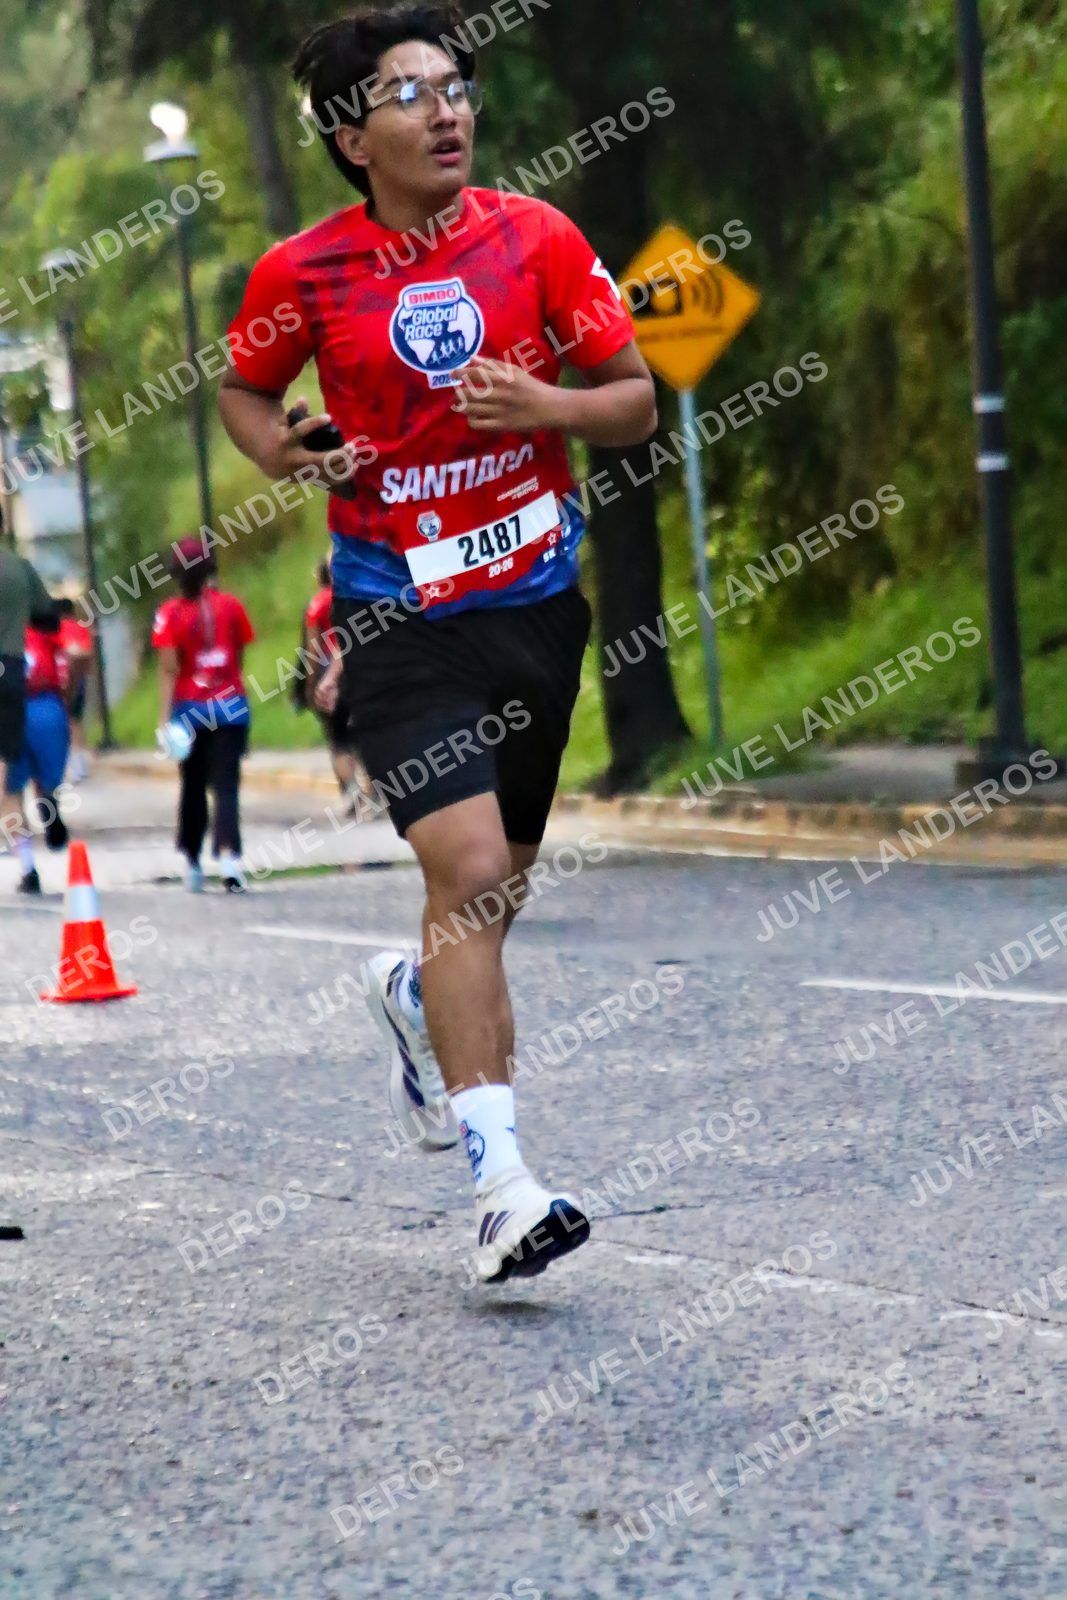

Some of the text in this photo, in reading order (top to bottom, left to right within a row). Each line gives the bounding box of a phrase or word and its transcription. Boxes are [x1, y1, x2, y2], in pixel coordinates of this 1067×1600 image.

[408, 288, 456, 305] BIMBO
[412, 303, 458, 326] Global
[405, 323, 443, 341] Race
[457, 514, 522, 568] 2487
